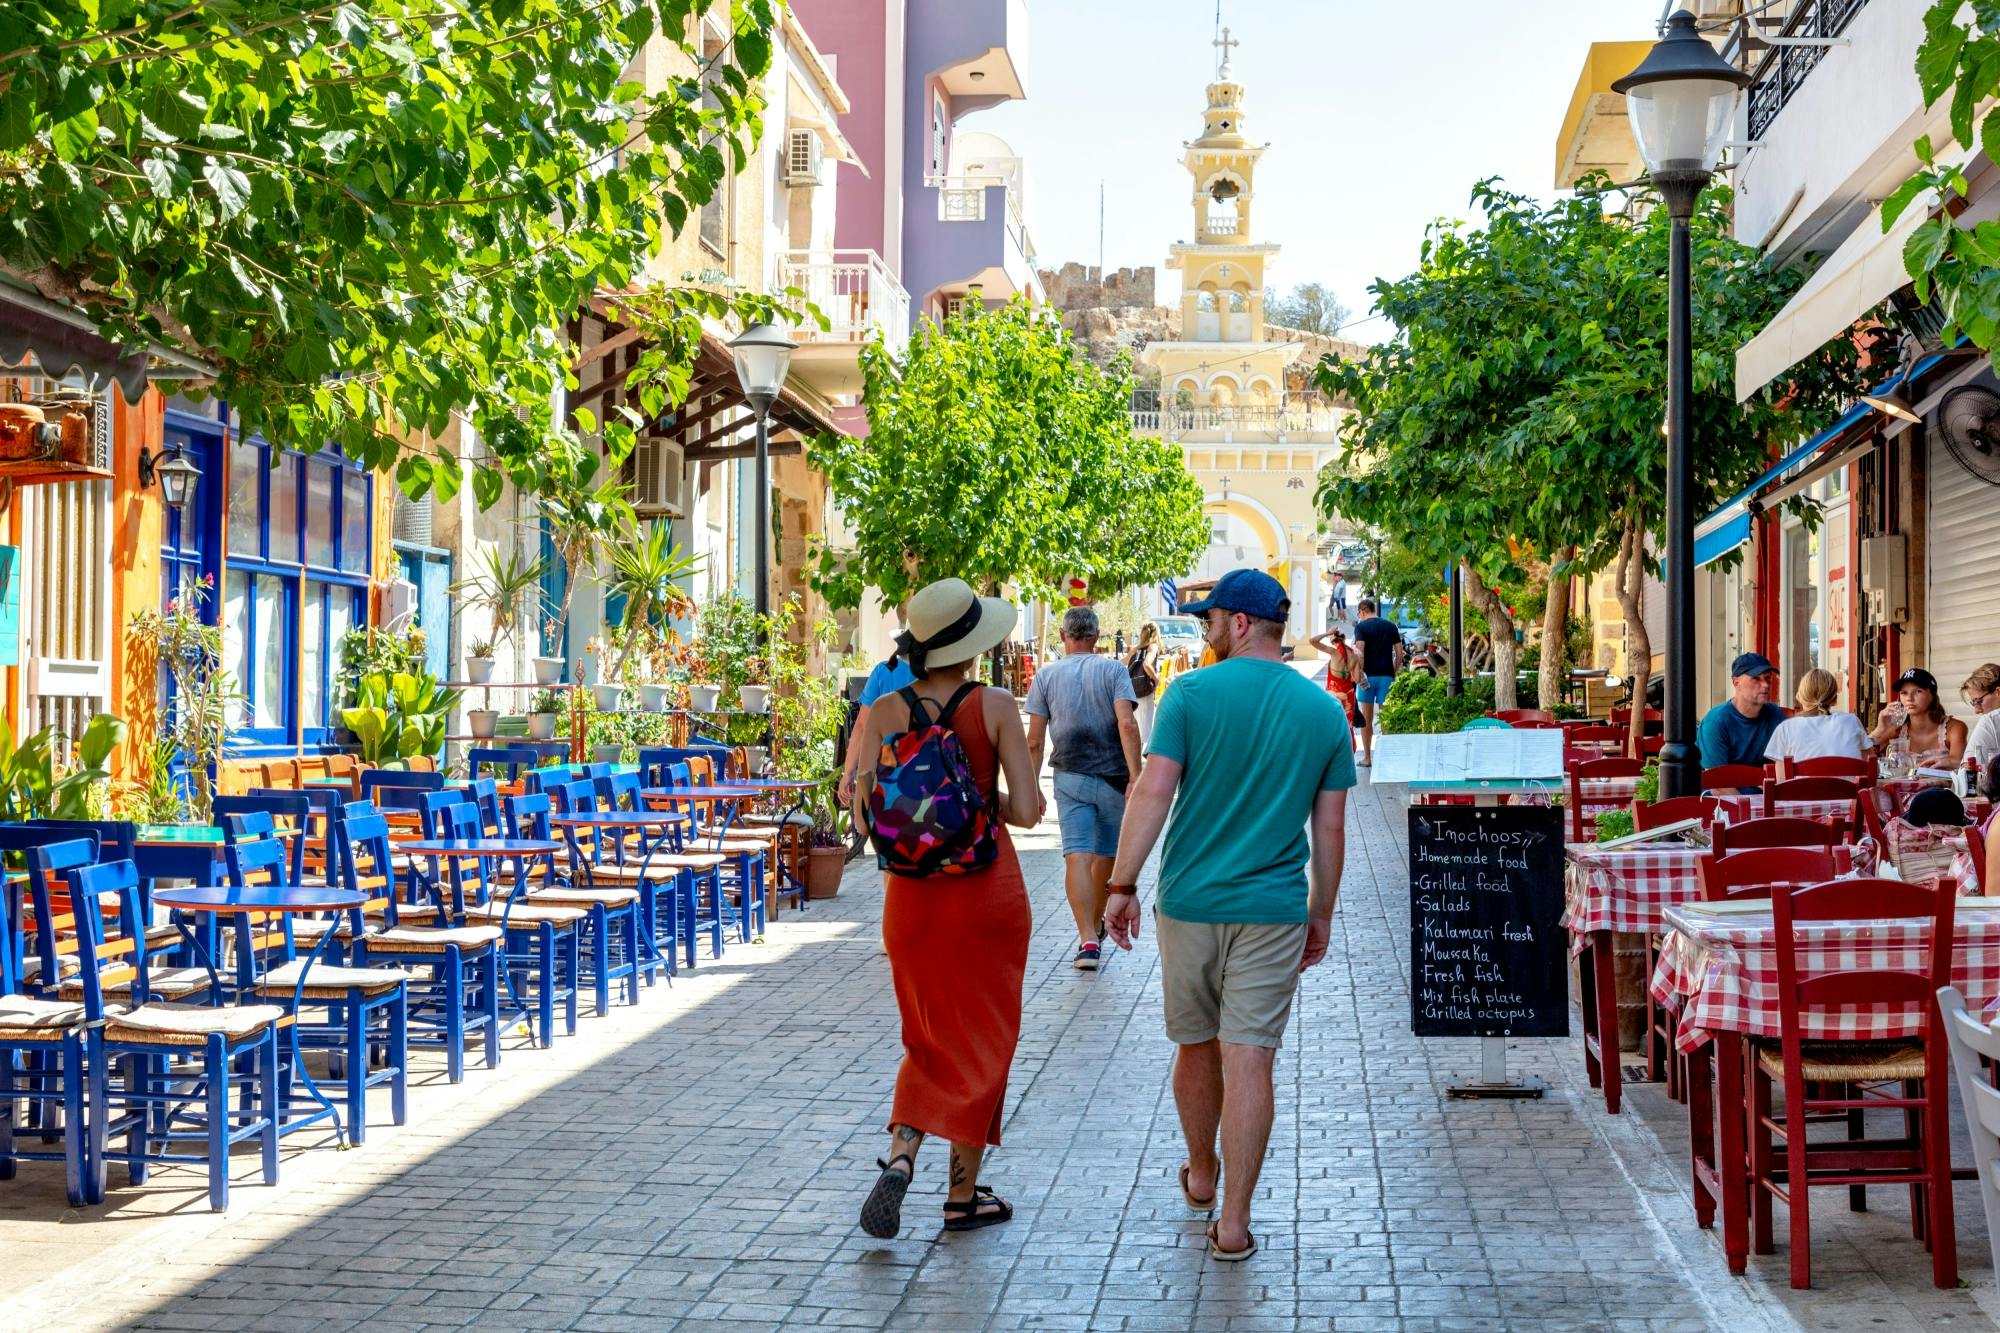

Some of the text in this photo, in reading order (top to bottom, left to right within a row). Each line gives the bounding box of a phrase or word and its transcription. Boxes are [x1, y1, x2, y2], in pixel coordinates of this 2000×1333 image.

[1830, 587, 1844, 633] SALE
[1418, 846, 1529, 870] Homemade food
[1419, 873, 1512, 893] Grilled food
[1420, 896, 1470, 912] Salads
[1424, 917, 1534, 942] Kalamari fresh
[1424, 965, 1504, 982] Fresh fish
[1423, 986, 1522, 1007] Mix fish plate
[1425, 1004, 1535, 1024] Grilled octopus
